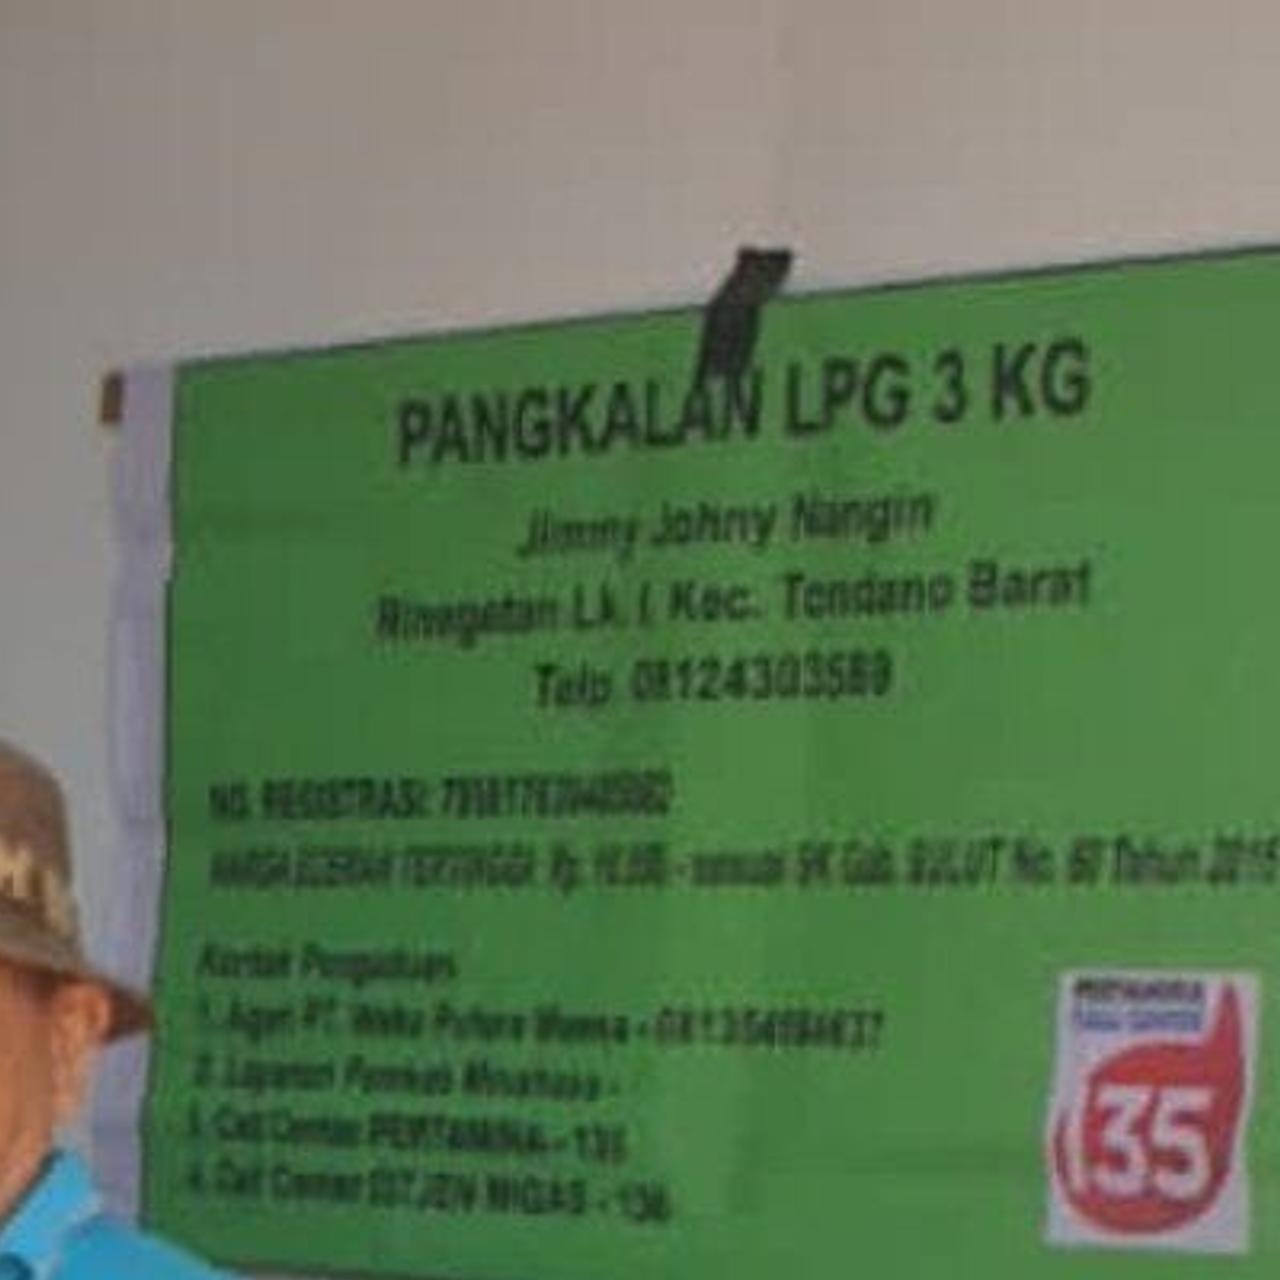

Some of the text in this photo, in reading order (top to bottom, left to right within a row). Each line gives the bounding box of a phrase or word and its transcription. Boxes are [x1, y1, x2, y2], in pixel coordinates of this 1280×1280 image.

[397, 339, 1092, 465] PANGKALAN LPG 3 KG
[968, 559, 1091, 610] Barat
